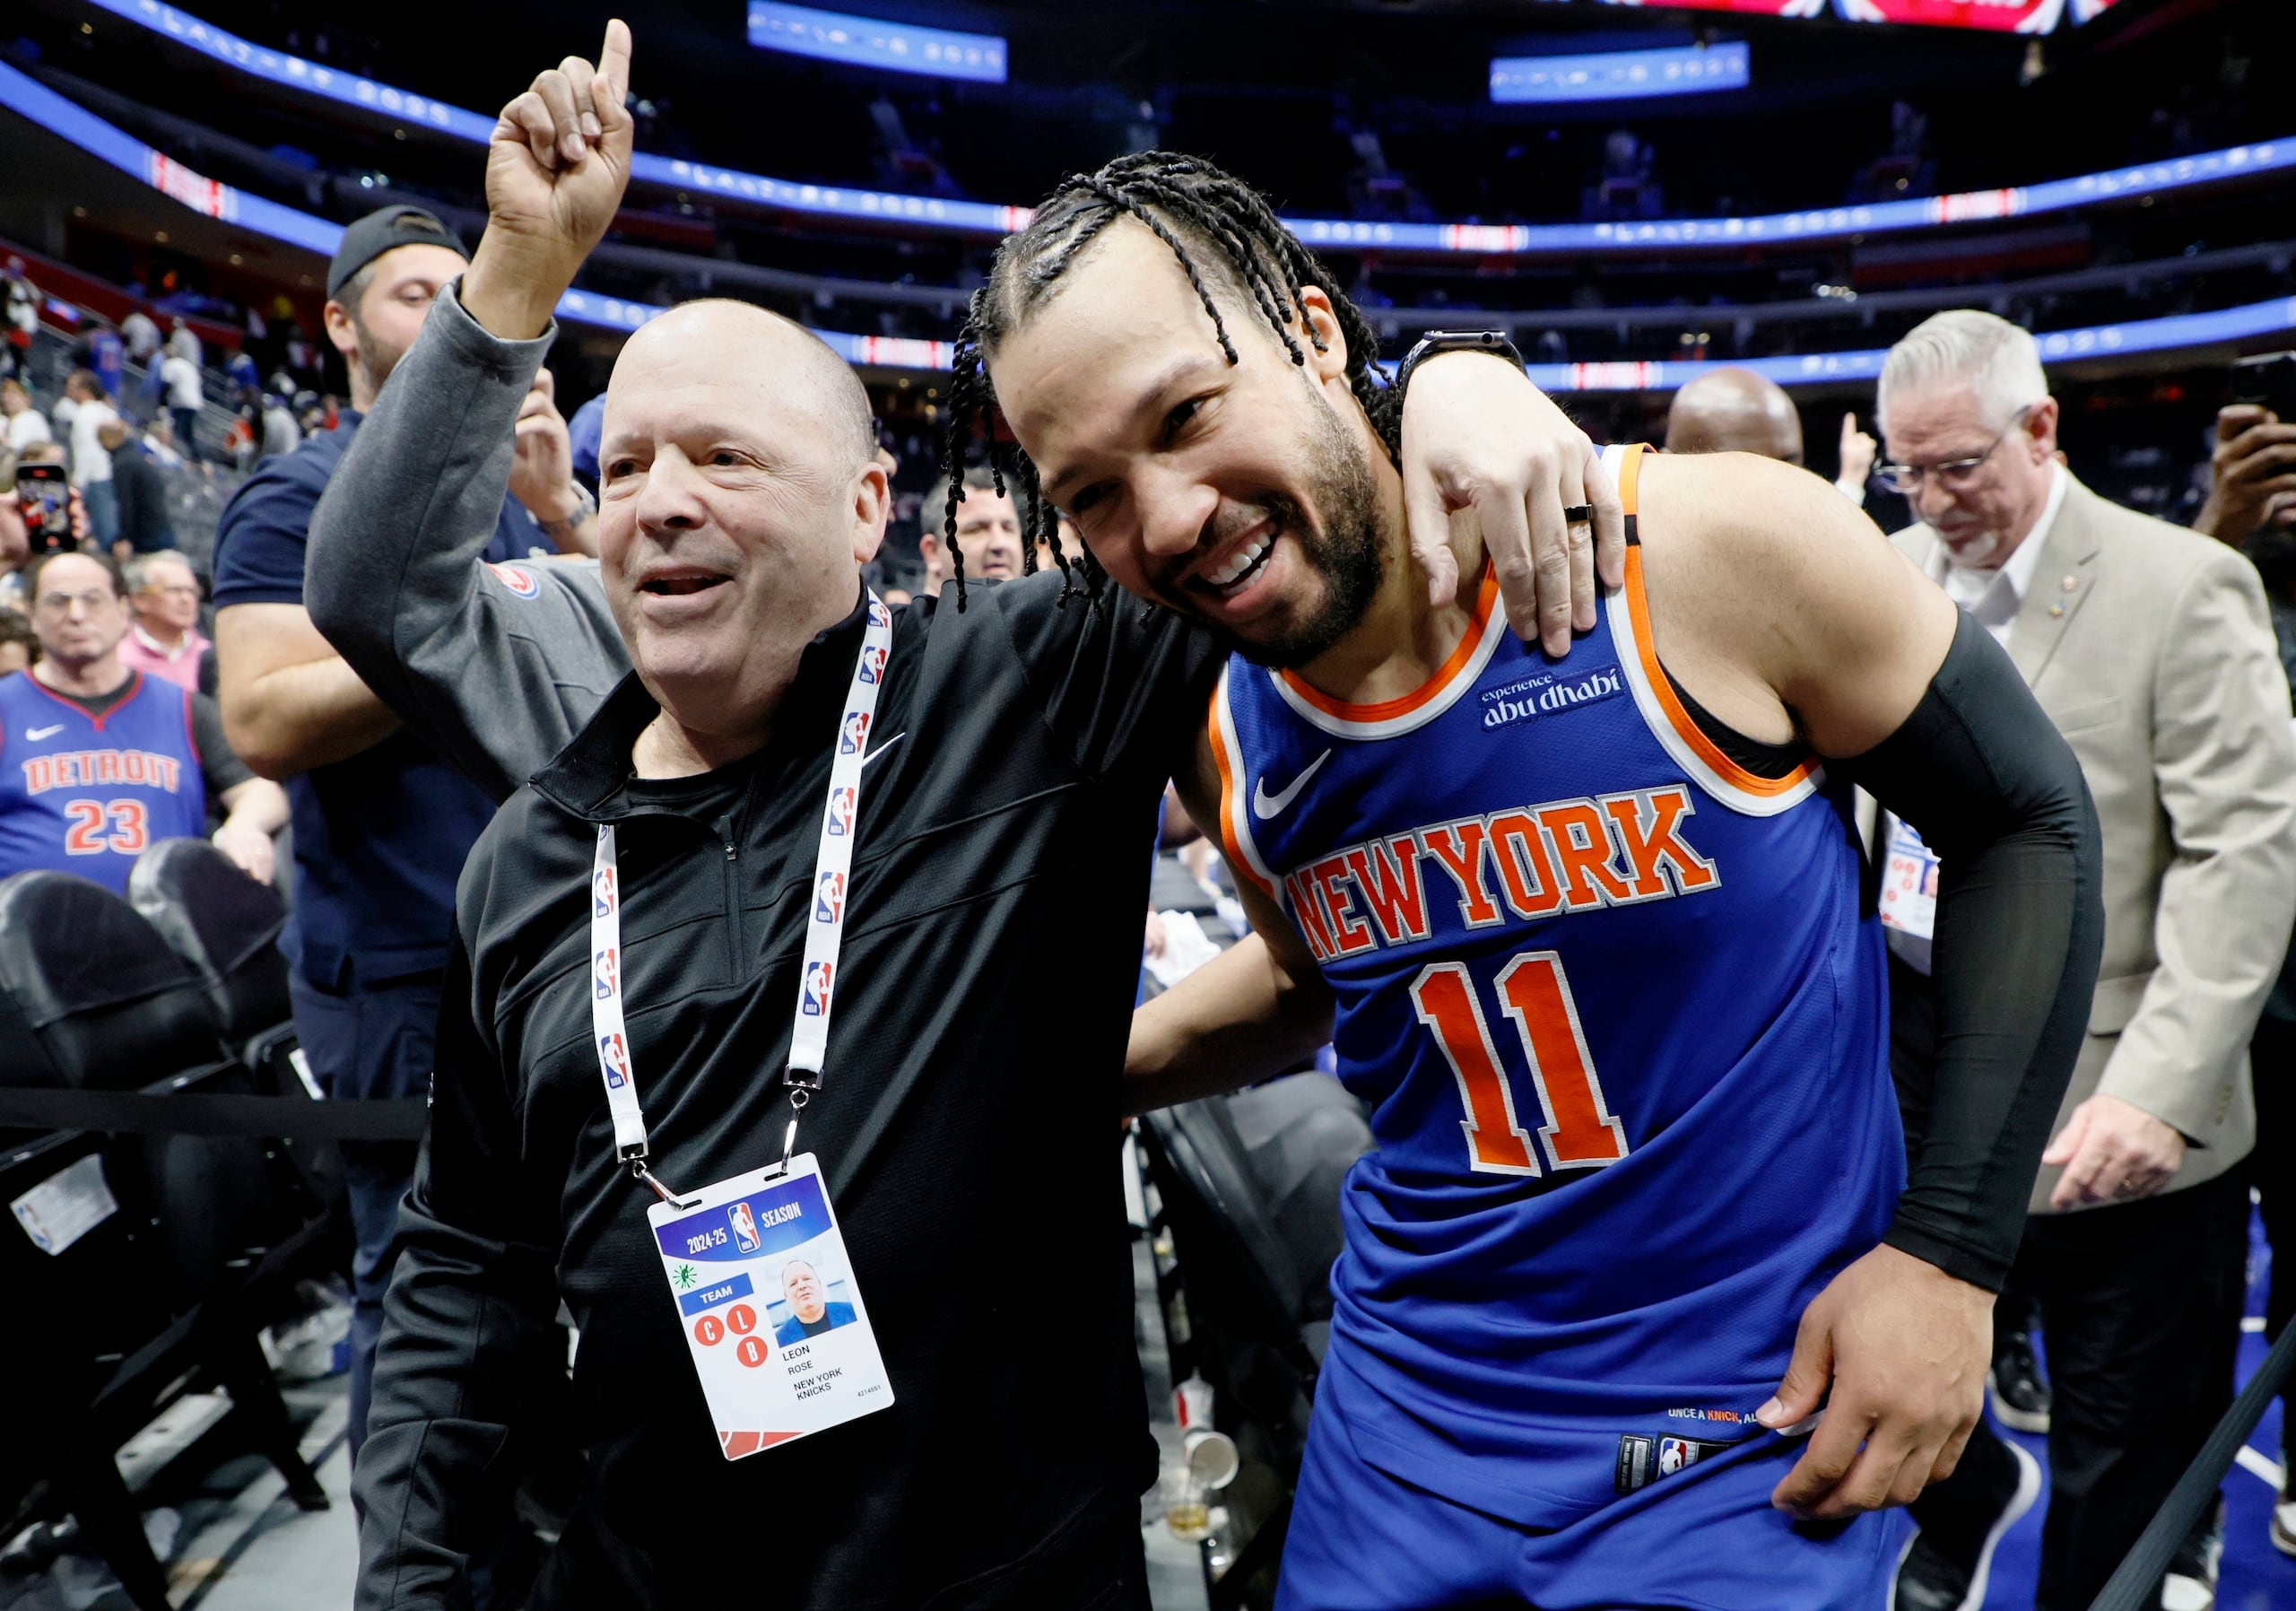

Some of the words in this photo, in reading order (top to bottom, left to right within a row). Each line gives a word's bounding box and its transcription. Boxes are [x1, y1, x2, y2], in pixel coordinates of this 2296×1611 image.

[860, 671, 873, 683] NBA
[1482, 674, 1552, 702] experience
[1483, 697, 1537, 727] abu
[1539, 667, 1622, 711] dhabi
[21, 748, 181, 797] DETROIT
[64, 798, 150, 856] 23
[830, 824, 843, 834] NBA
[1285, 831, 1432, 965] NEW
[1414, 783, 1722, 931] YORK
[817, 910, 831, 921] NBA
[804, 1003, 818, 1014] NBA
[1408, 950, 1630, 1178] 11
[687, 1227, 728, 1255] 2024-25
[761, 1201, 803, 1229] SEASON
[700, 1284, 734, 1304] TEAM
[703, 1320, 716, 1342] C
[735, 1310, 748, 1330] L
[745, 1341, 760, 1363] B
[782, 1345, 810, 1362] LEON
[787, 1360, 813, 1375] ROSE
[794, 1377, 814, 1391] NEW
[816, 1368, 843, 1383] YORK
[796, 1382, 832, 1401] KNICKS
[1668, 1407, 1697, 1419] ONCE
[1698, 1409, 1705, 1420] A
[1707, 1409, 1743, 1424] KNICK,
